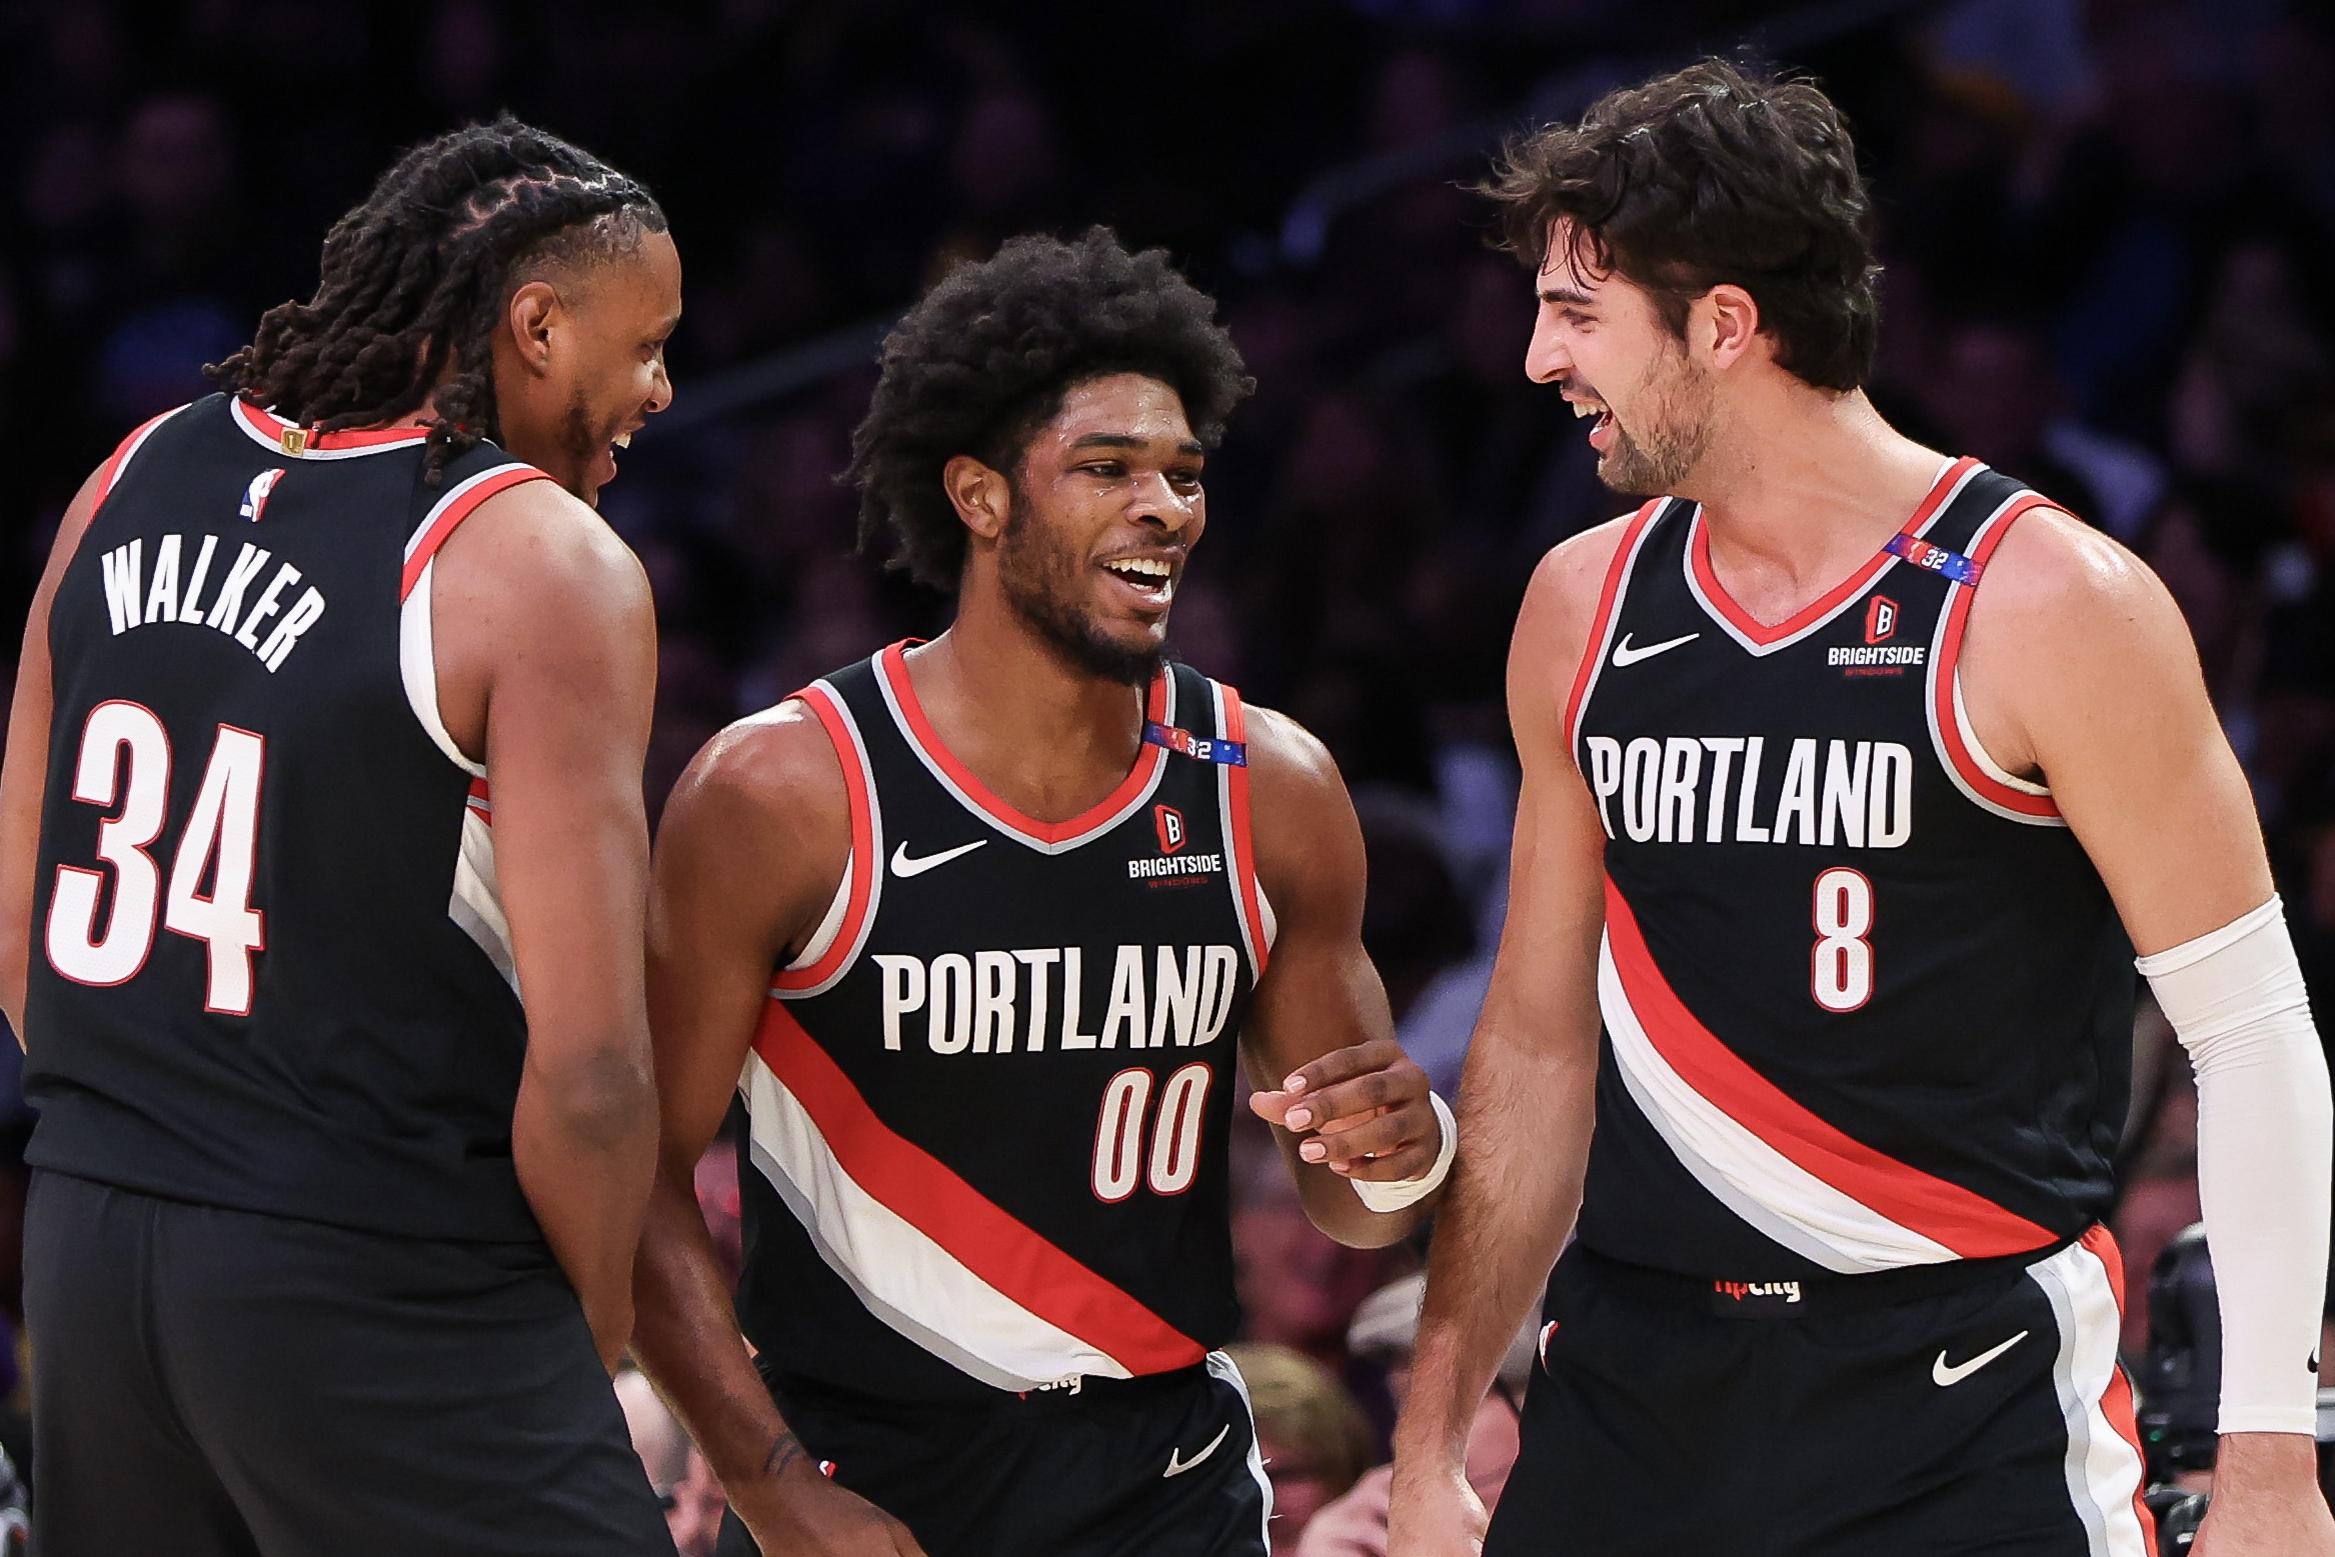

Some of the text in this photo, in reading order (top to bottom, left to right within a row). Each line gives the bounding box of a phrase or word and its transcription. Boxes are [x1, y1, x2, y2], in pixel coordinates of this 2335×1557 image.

[1921, 549, 1949, 570] 32
[102, 534, 326, 674] WALKER
[1876, 604, 1894, 636] B
[1828, 646, 1926, 666] BRIGHTSIDE
[1186, 736, 1213, 760] 32
[1586, 736, 1912, 848] PORTLAND
[45, 699, 266, 1017] 34
[1164, 812, 1181, 845] B
[1128, 854, 1222, 878] BRIGHTSIDE
[1811, 866, 1874, 1013] 8
[871, 944, 1239, 1054] PORTLAND
[1091, 1061, 1213, 1204] 00
